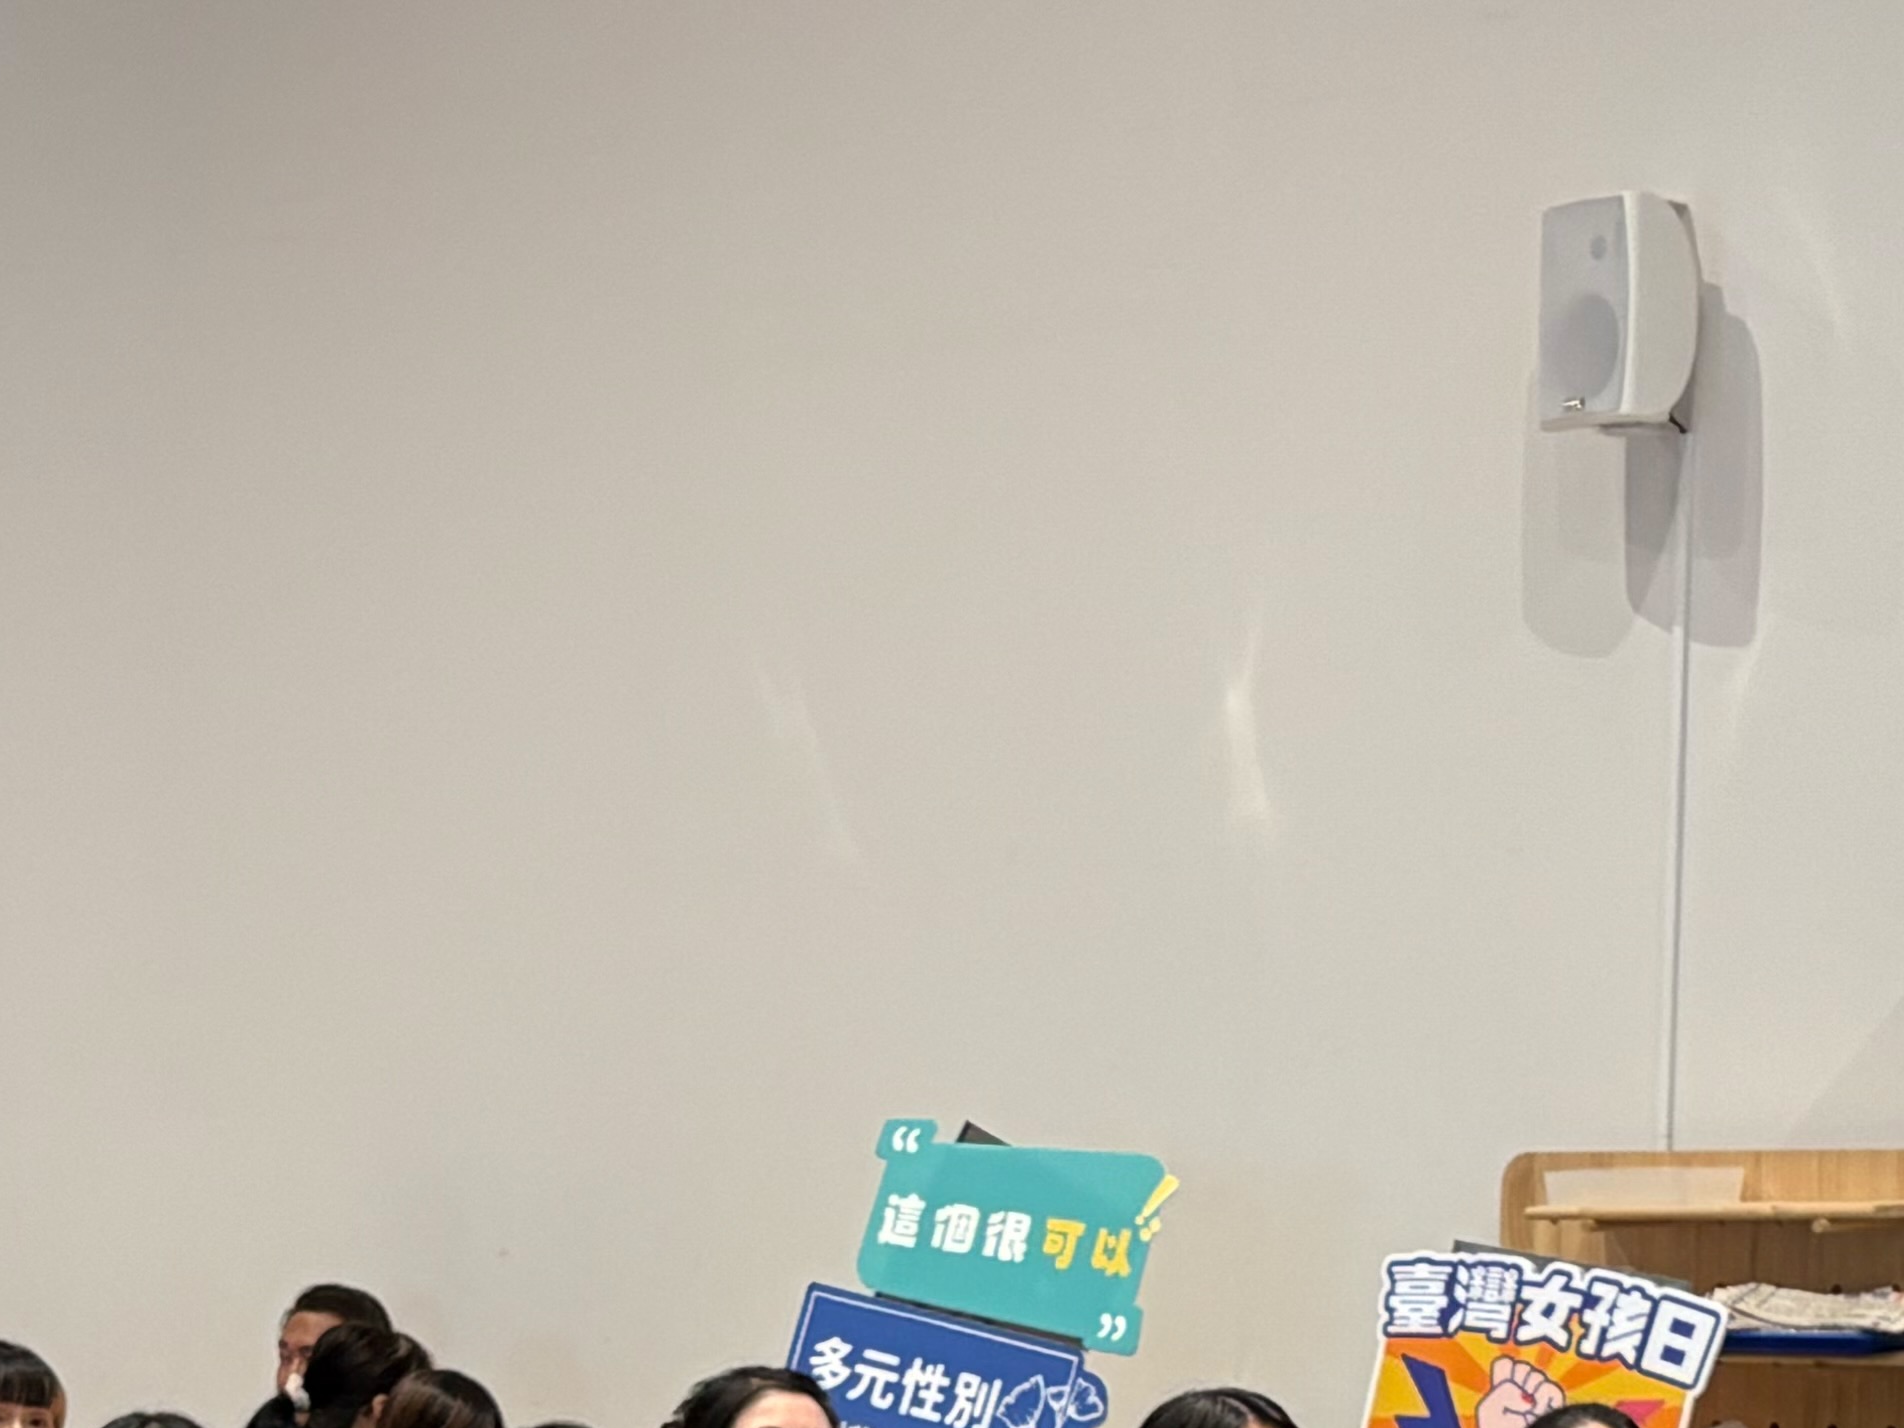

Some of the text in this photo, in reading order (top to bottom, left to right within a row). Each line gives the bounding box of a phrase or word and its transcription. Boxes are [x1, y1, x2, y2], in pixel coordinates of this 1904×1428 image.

[877, 1193, 1132, 1277] 這個很可以
[1386, 1258, 1718, 1385] 臺灣女孩日
